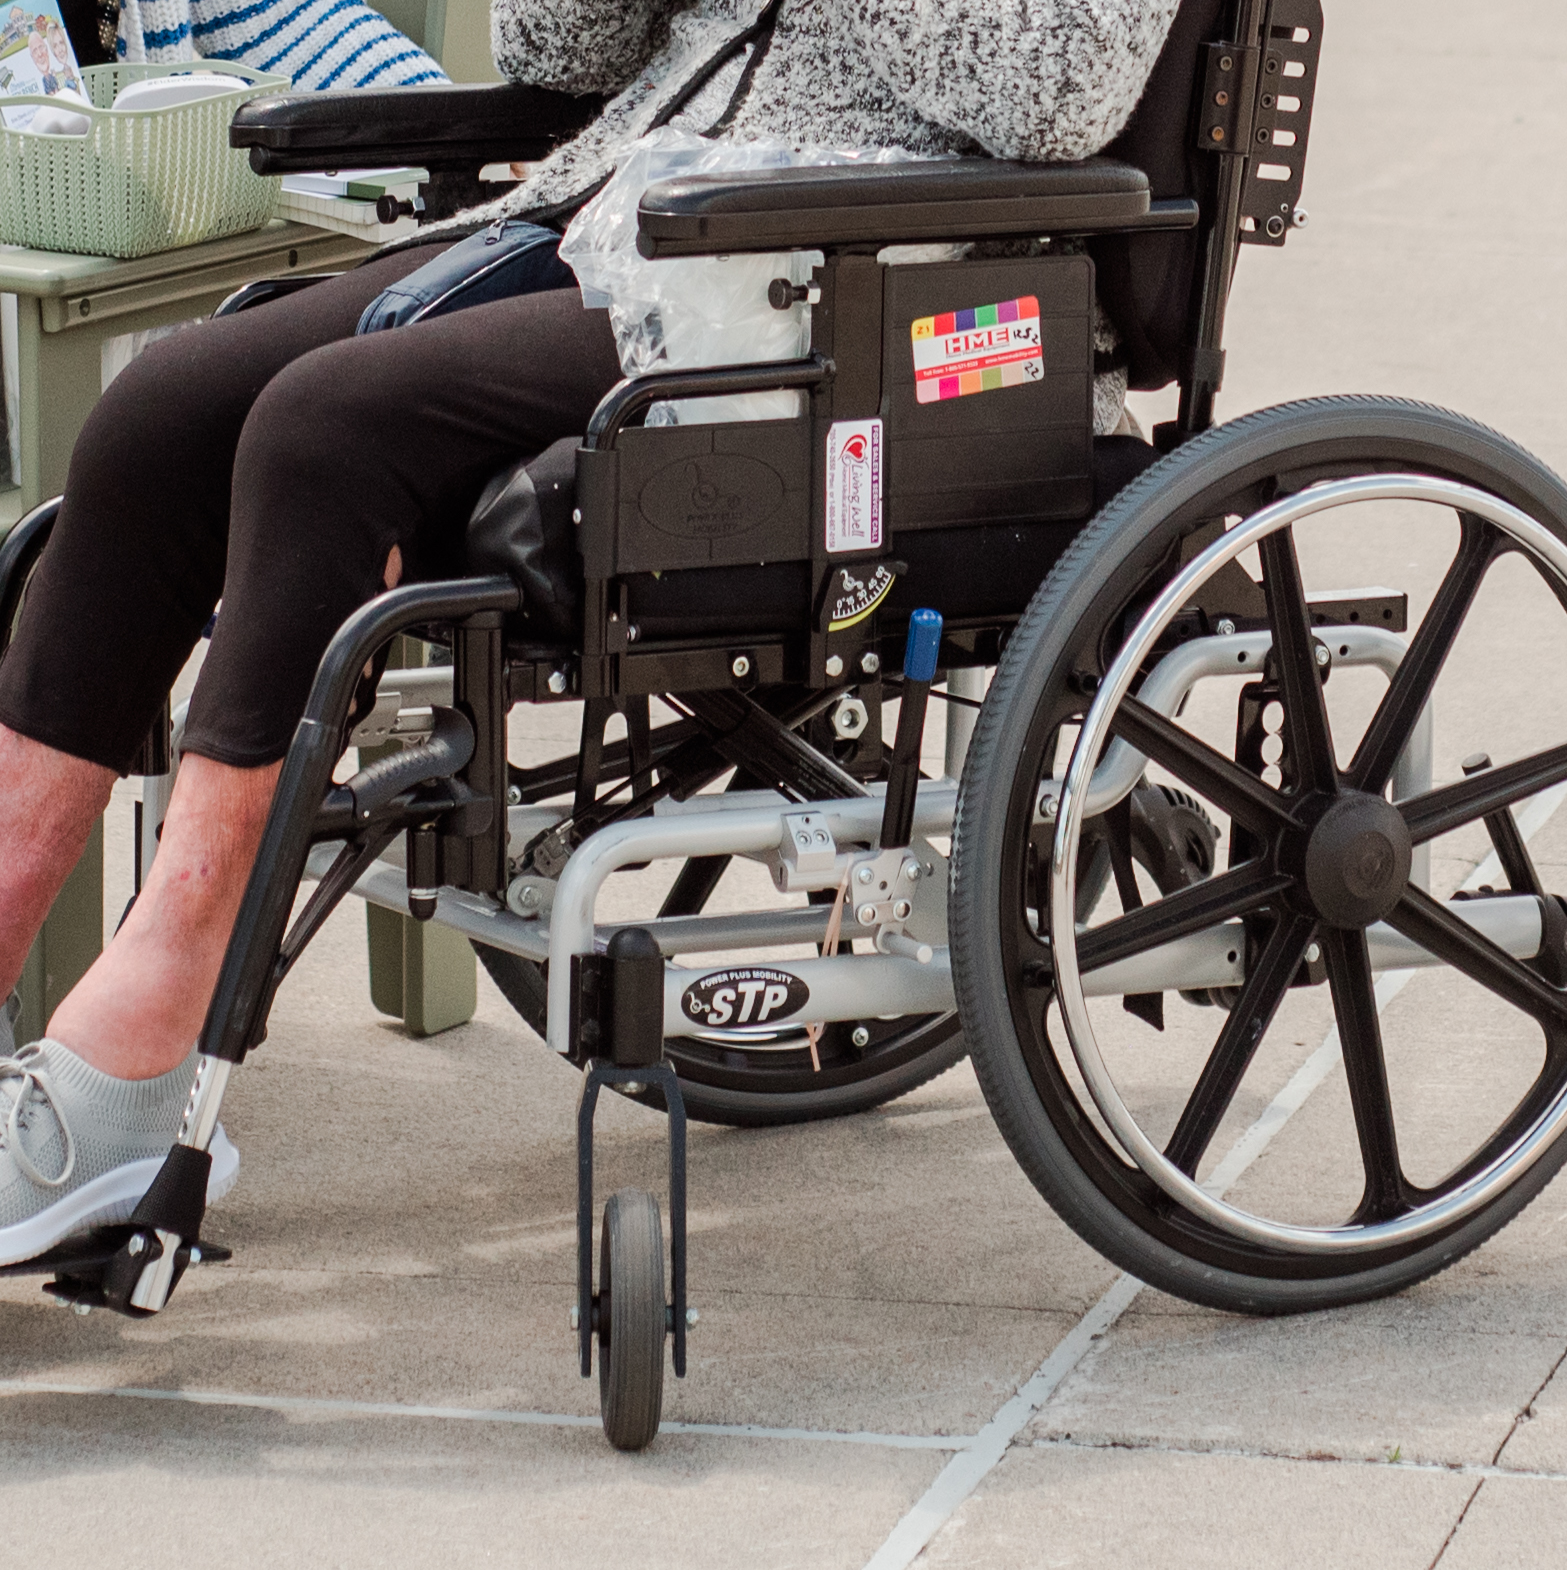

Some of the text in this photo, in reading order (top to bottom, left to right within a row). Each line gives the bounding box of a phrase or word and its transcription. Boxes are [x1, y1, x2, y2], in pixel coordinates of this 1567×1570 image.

[945, 328, 1009, 354] HME
[872, 426, 880, 445] FOR
[872, 446, 880, 473] SALES
[848, 463, 864, 504] Living
[871, 520, 879, 543] CALL
[699, 970, 793, 990] POWER PLUS MOBILITY
[707, 980, 788, 1025] STP
